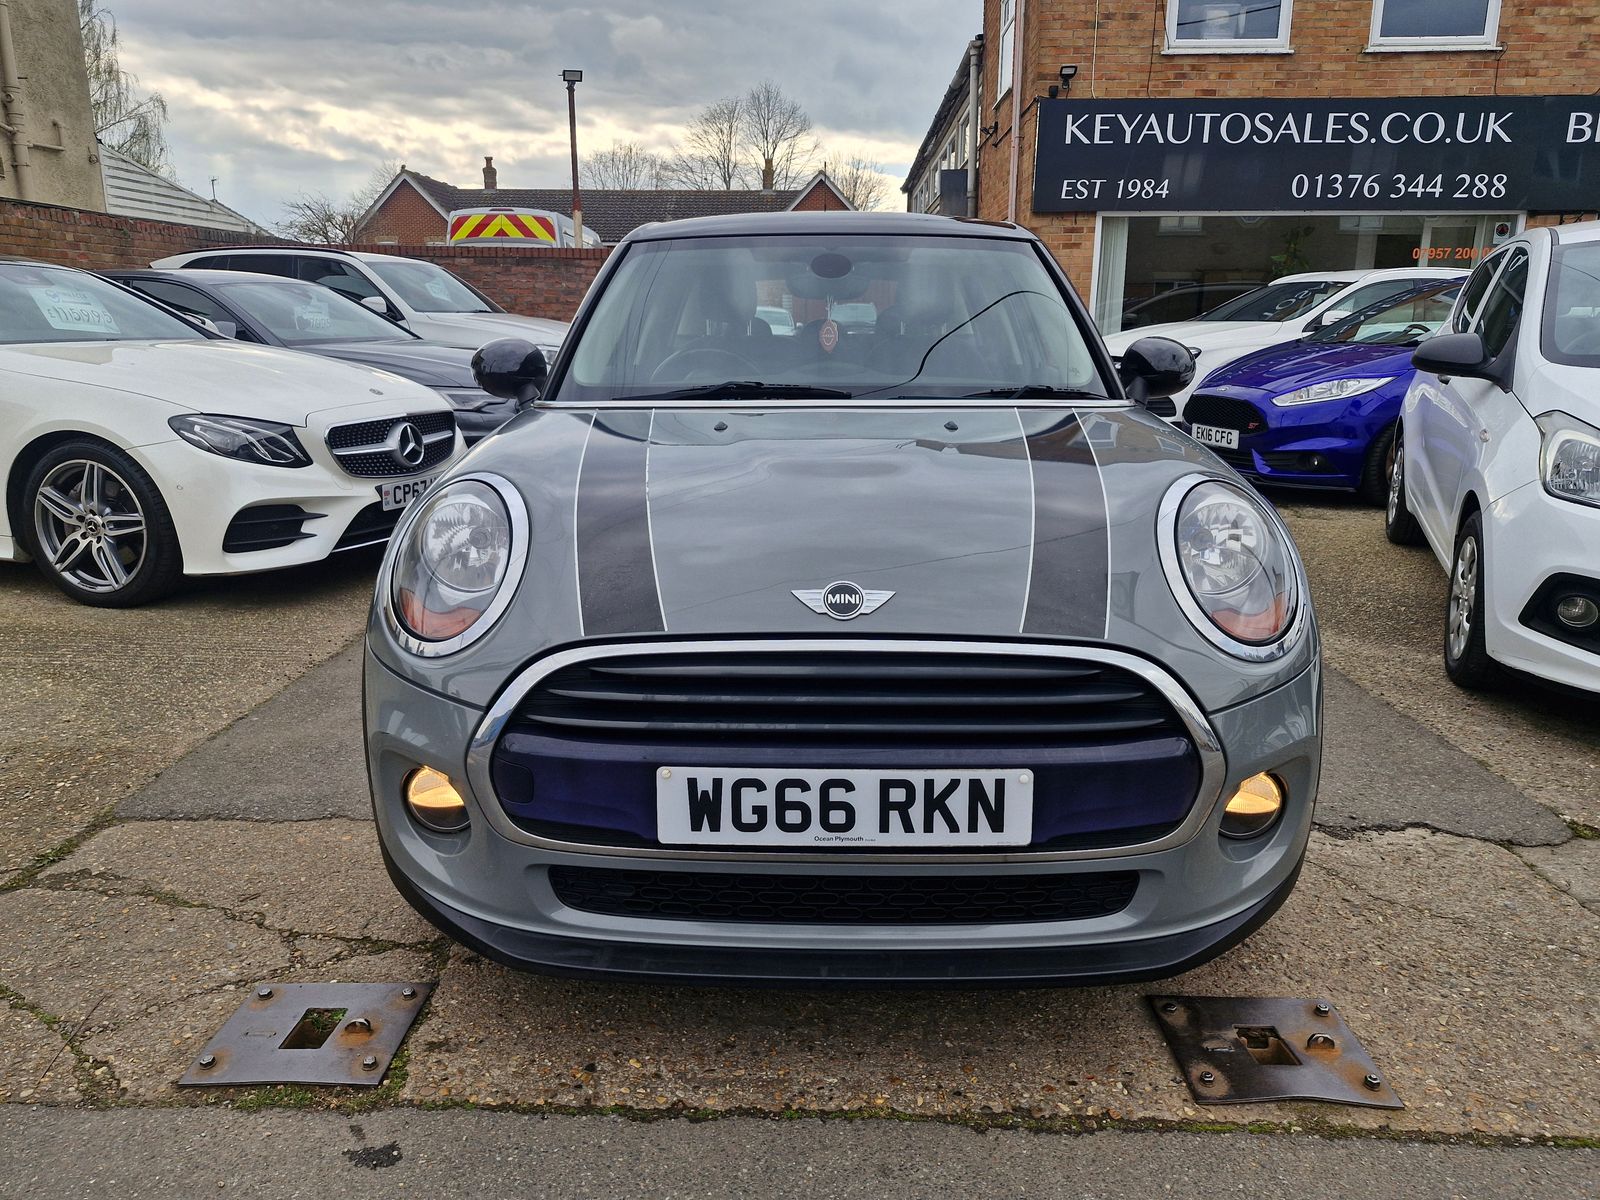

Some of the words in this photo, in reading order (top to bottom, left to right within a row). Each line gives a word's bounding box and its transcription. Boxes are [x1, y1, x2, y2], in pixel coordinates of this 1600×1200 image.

[1064, 112, 1514, 145] KEYAUTOSALES.CO.UK
[1565, 112, 1600, 143] B
[1060, 179, 1107, 199] EST
[1116, 178, 1170, 199] 1984
[1291, 173, 1381, 199] 01376
[1389, 173, 1444, 199] 344
[1452, 173, 1508, 199] 288
[1412, 247, 1452, 260] 07957
[1454, 247, 1478, 260] 200
[1196, 426, 1213, 442] EK16
[1214, 429, 1233, 445] CFG
[827, 593, 860, 605] MINI
[686, 777, 856, 833] WG66
[878, 778, 1006, 834] RKN
[835, 835, 864, 843] Plymouth
